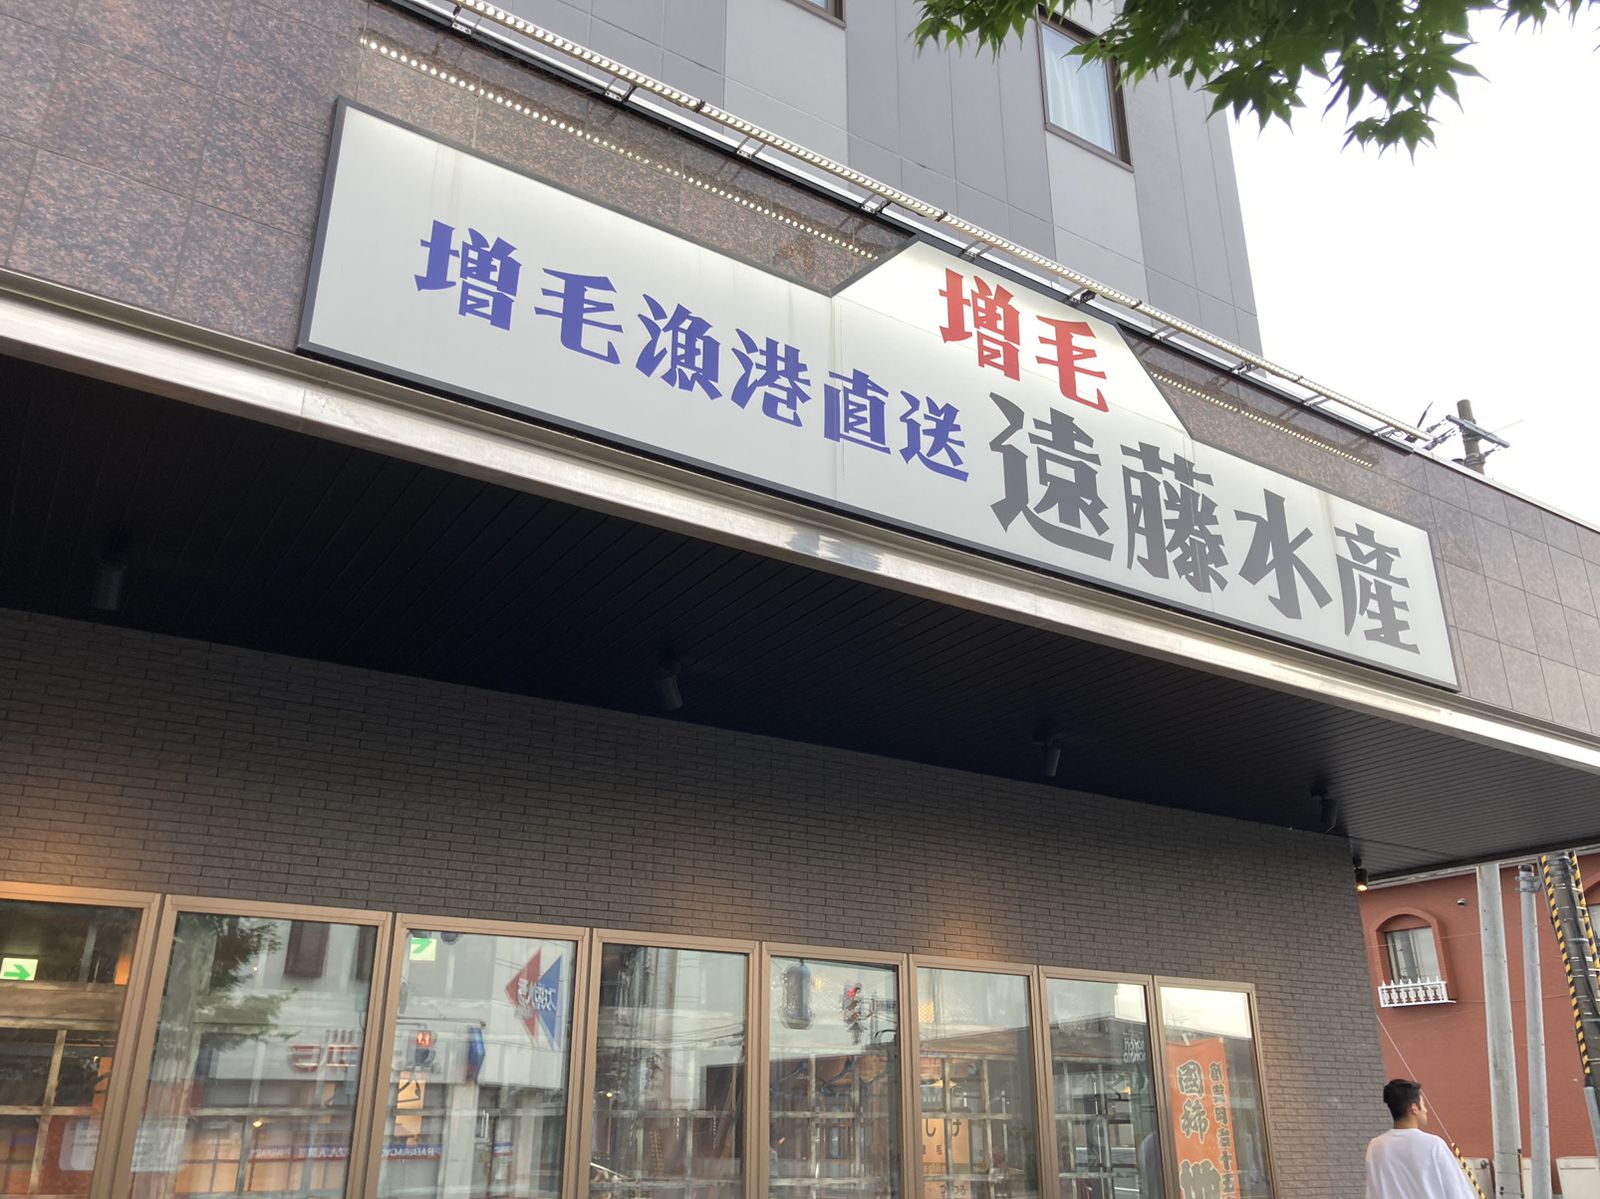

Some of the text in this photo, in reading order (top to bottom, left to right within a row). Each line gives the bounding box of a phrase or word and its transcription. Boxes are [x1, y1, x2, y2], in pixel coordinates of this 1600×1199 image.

[414, 219, 969, 482] 増毛漁港直送
[938, 268, 1109, 413] 増毛
[988, 391, 1421, 655] 遠藤水産
